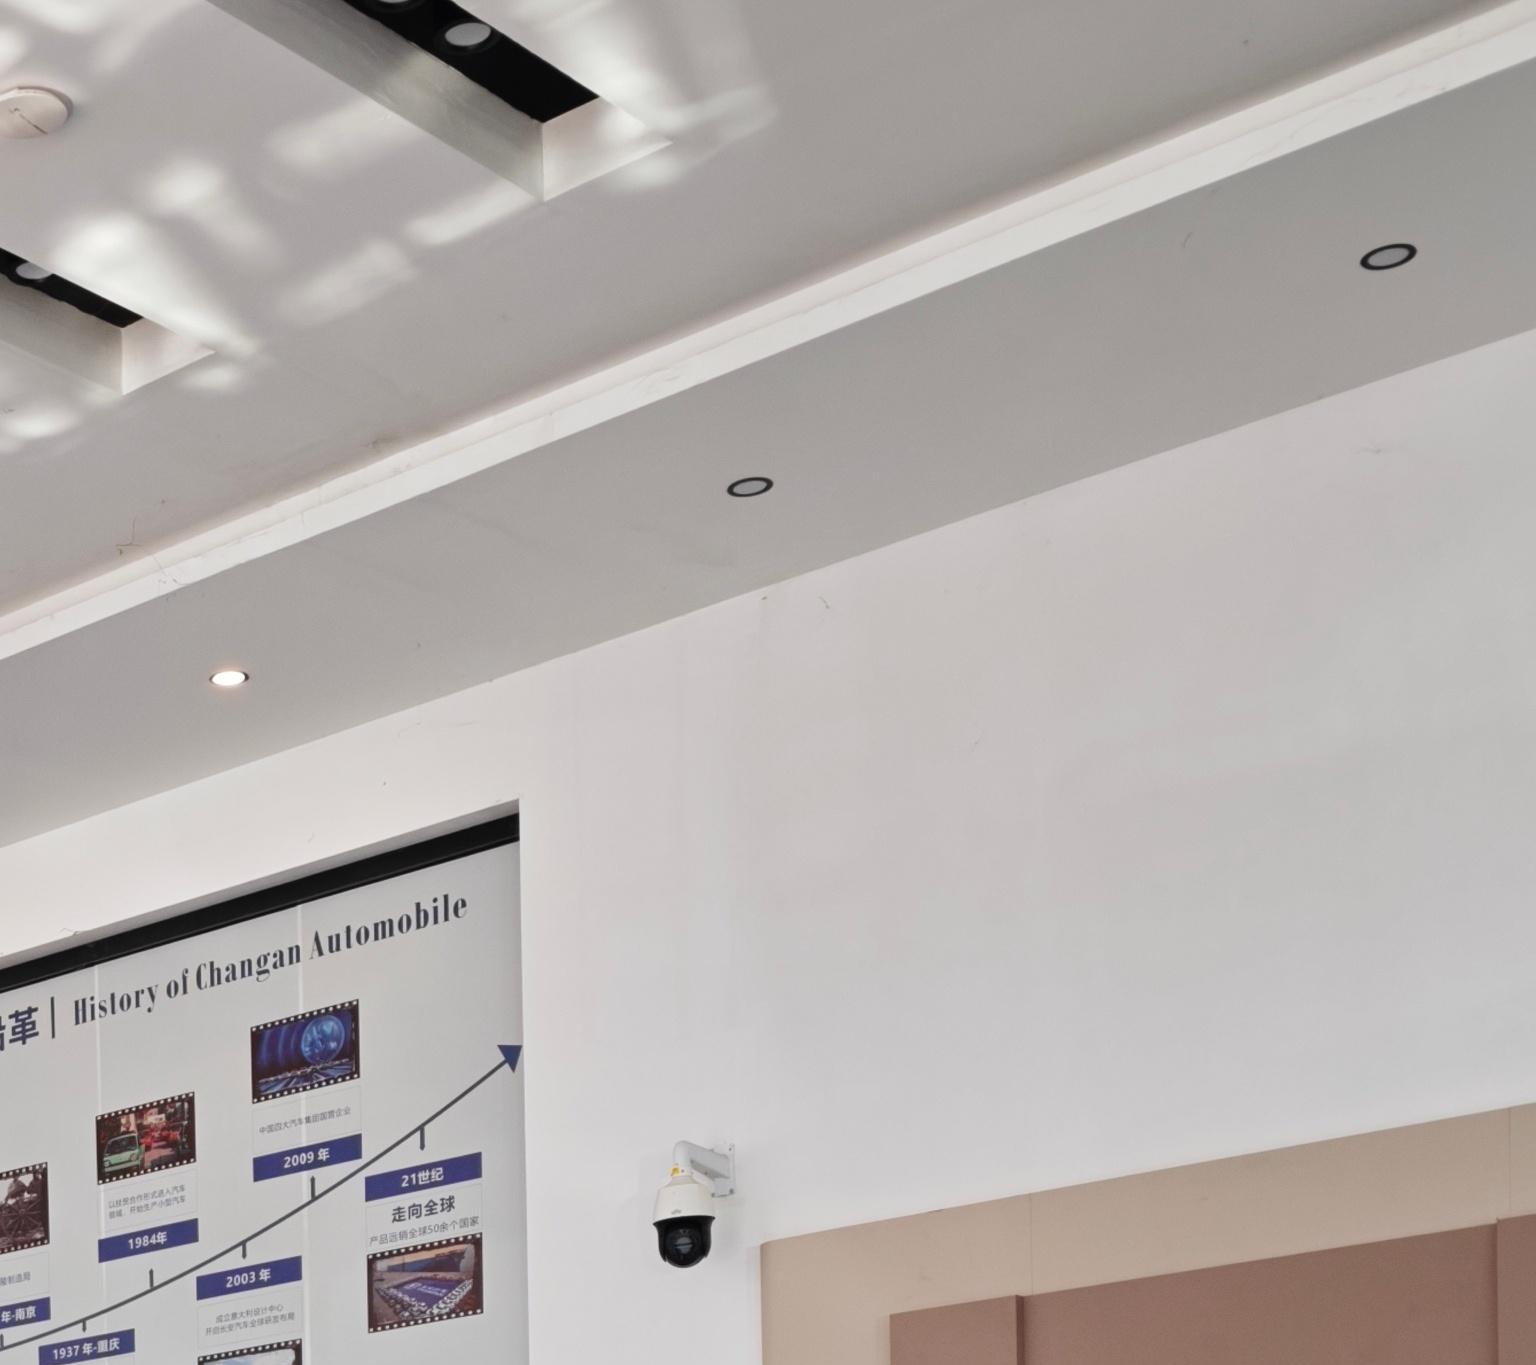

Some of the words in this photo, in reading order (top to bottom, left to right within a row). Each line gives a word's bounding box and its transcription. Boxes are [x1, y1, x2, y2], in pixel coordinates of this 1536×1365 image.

[74, 983, 159, 1026] History
[166, 969, 191, 999] of
[196, 943, 301, 990] Changan
[308, 894, 468, 959] Automobile
[283, 1152, 314, 1168] 2009
[401, 1167, 444, 1187] 21世纪
[392, 1195, 455, 1223] 走向全球
[128, 1231, 167, 1250] 1984年
[369, 1216, 479, 1247] 产品远销全球50余个国家
[226, 1272, 256, 1288] 2003
